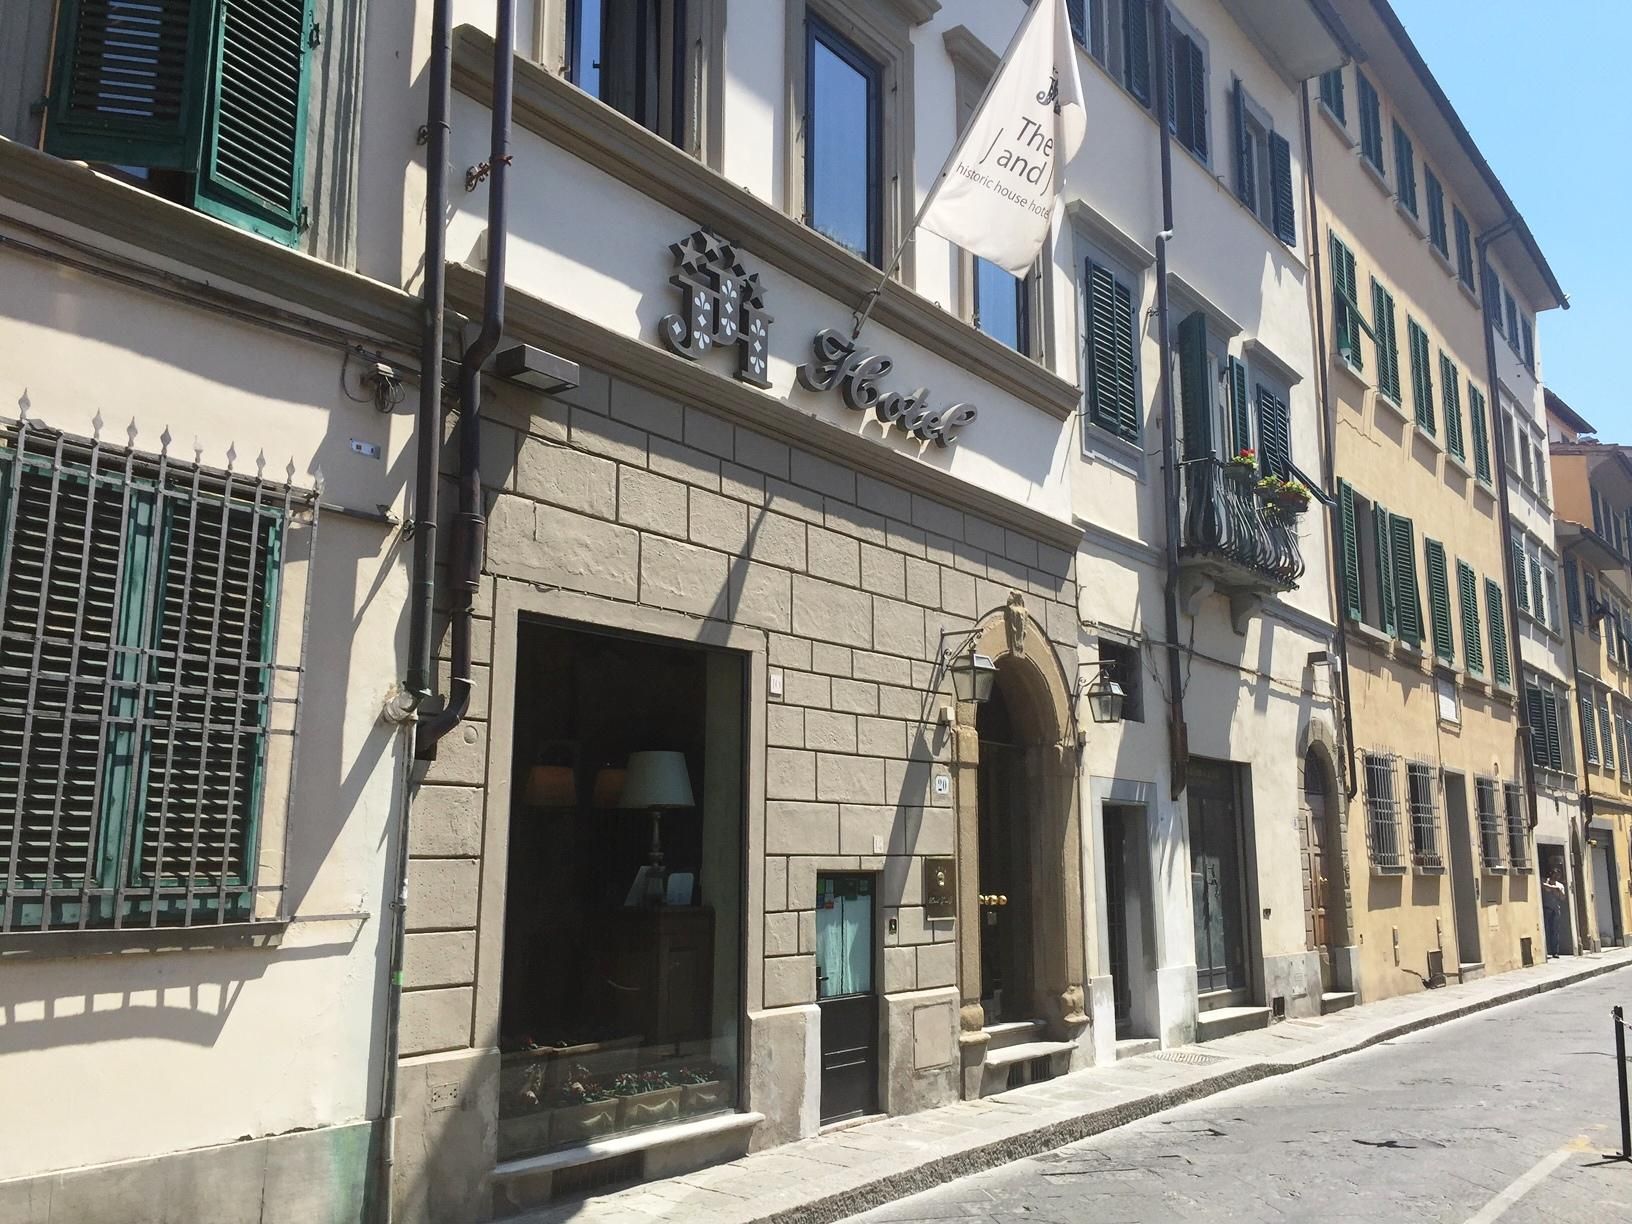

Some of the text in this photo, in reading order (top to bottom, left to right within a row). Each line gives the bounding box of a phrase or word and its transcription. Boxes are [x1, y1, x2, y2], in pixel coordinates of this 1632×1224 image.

[1016, 116, 1054, 157] The
[956, 161, 1051, 221] historic house hote
[997, 148, 1047, 186] and
[796, 327, 978, 449] Hotel
